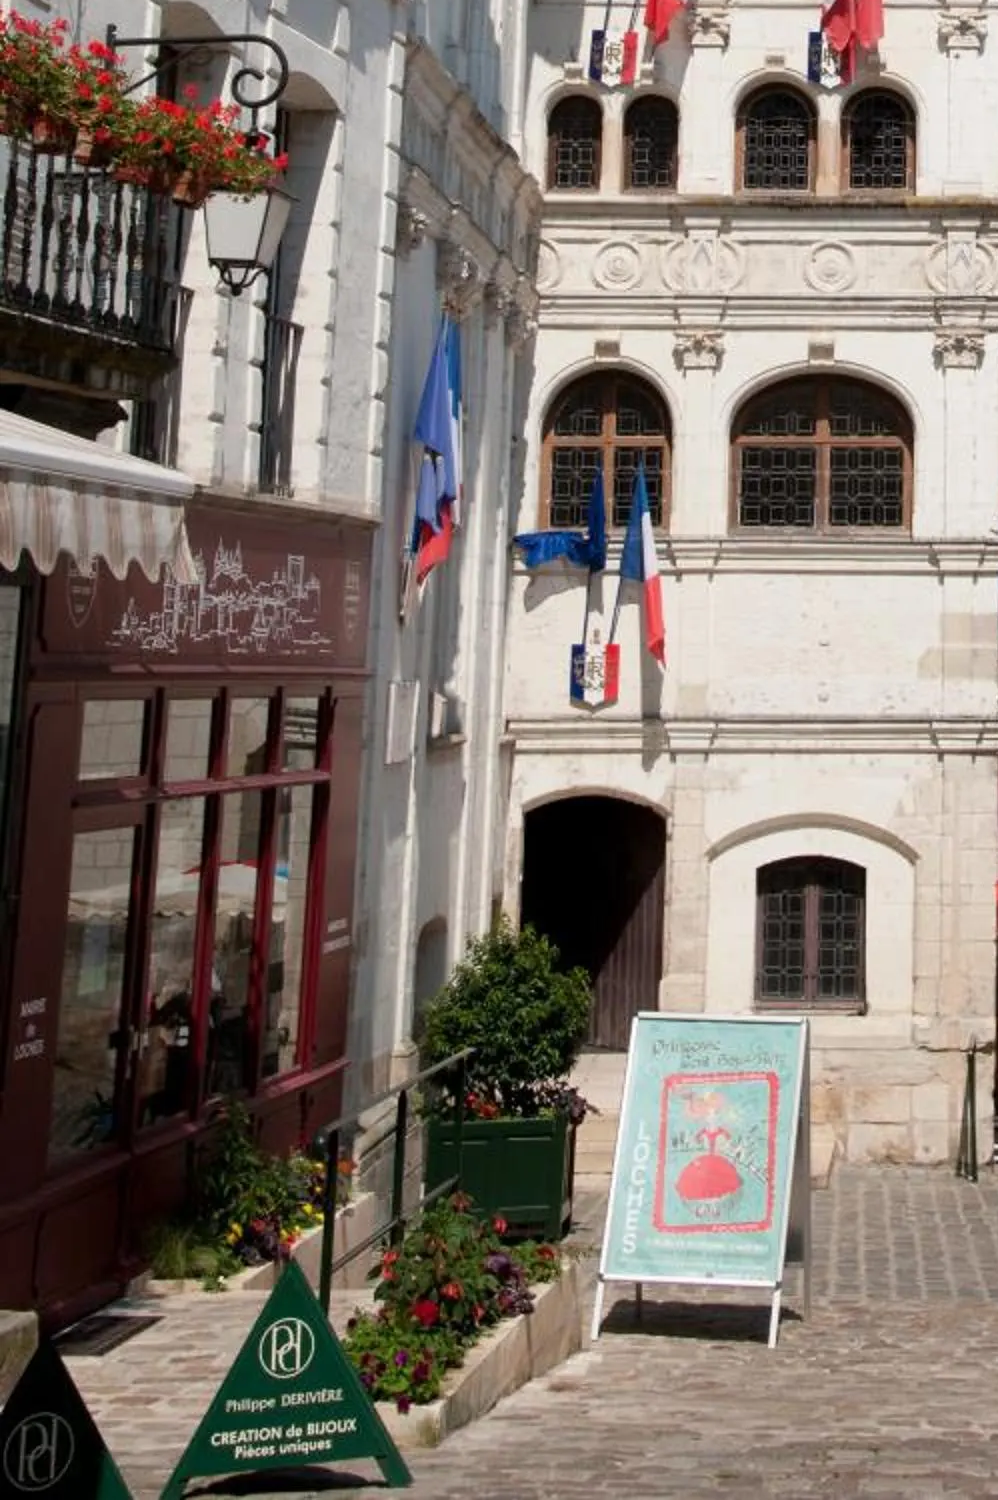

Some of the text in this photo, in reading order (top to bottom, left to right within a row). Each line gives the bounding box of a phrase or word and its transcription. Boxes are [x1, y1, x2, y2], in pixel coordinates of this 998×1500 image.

[622, 1118, 652, 1255] LOCHES
[225, 1398, 277, 1413] Philippe
[210, 1417, 358, 1447] CREATION de BIJOUX
[279, 1438, 333, 1454] uniques
